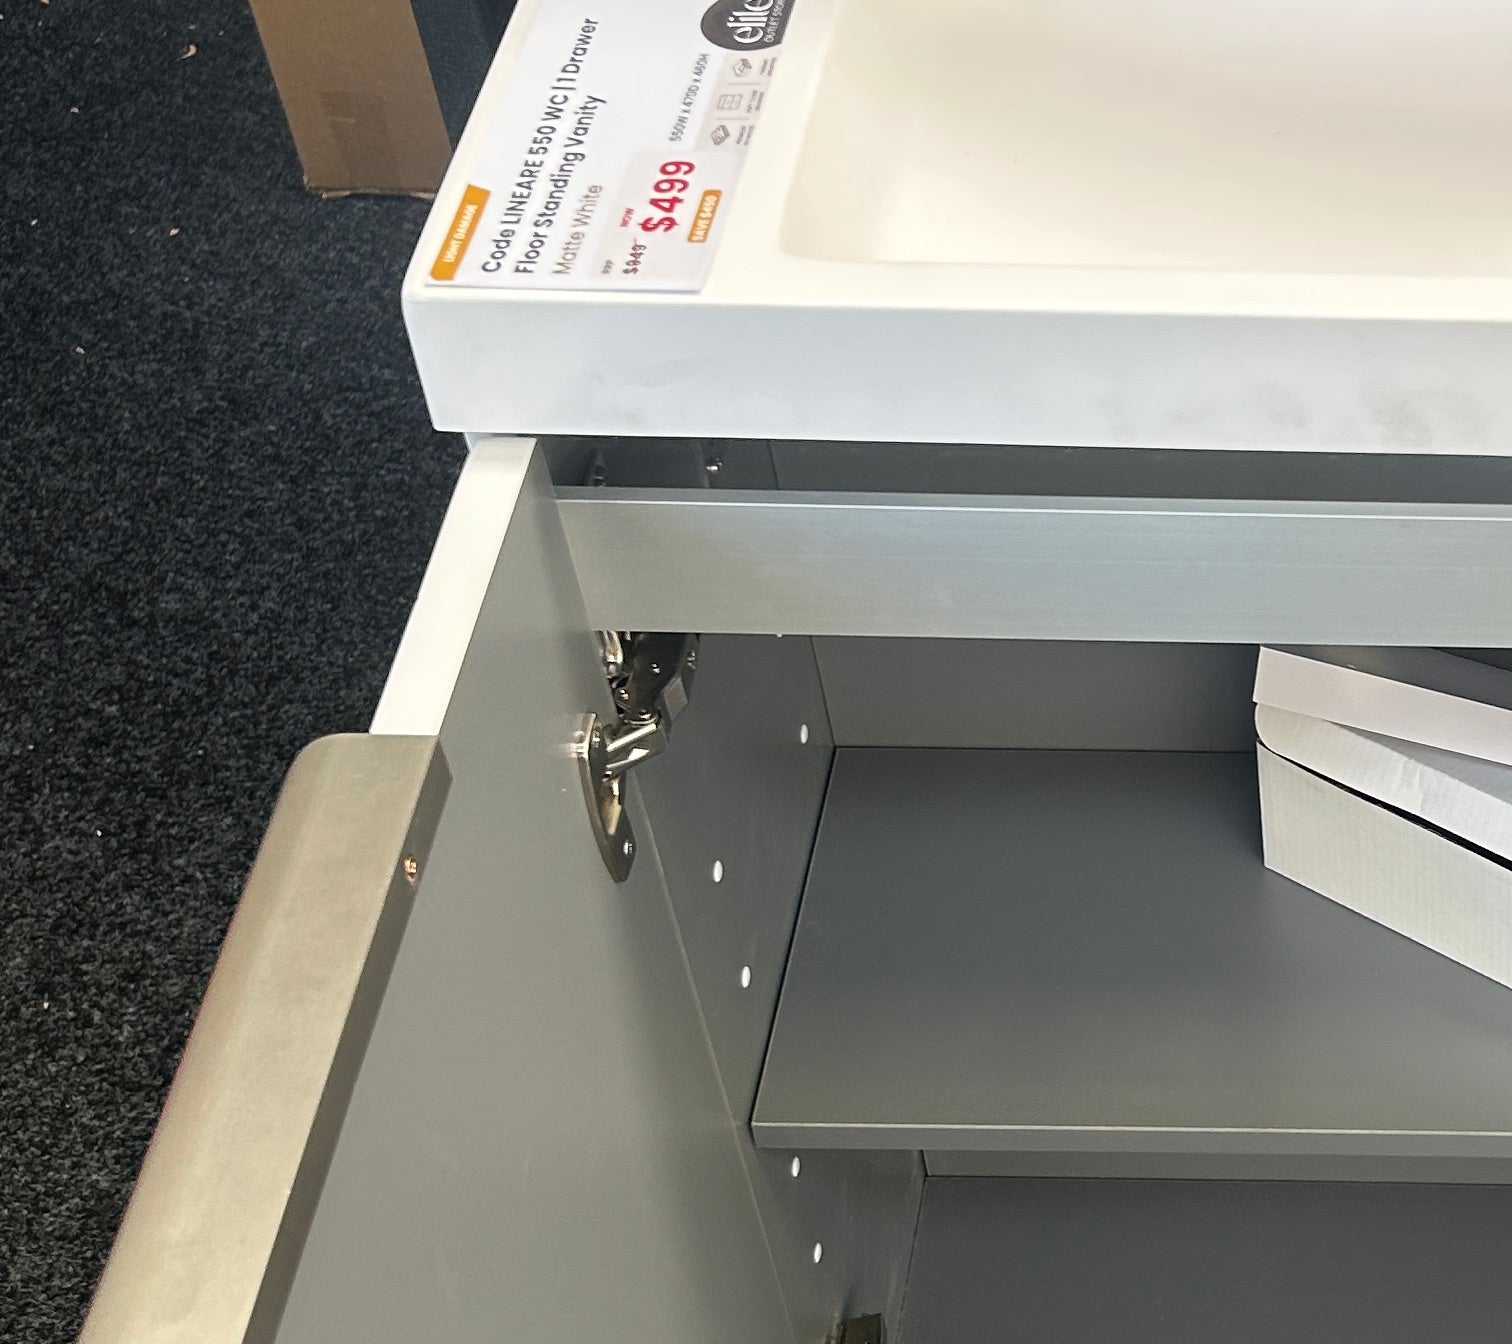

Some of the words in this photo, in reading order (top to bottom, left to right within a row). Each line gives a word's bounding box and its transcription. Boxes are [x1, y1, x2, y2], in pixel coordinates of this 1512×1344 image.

[561, 18, 599, 73] Drawer
[764, 16, 780, 43] OUTLET
[541, 94, 569, 121] WC
[528, 126, 556, 155] 550
[502, 160, 544, 226] LINEARE
[514, 232, 547, 274] Floor
[533, 153, 584, 228] Standing
[564, 95, 607, 148] Vanity
[638, 161, 696, 232] $499
[453, 204, 479, 240] DAMAGE
[552, 232, 586, 275] Matte
[573, 184, 602, 228] White
[620, 208, 635, 228] NOW
[692, 219, 710, 241] SAVE
[481, 229, 515, 273] Code
